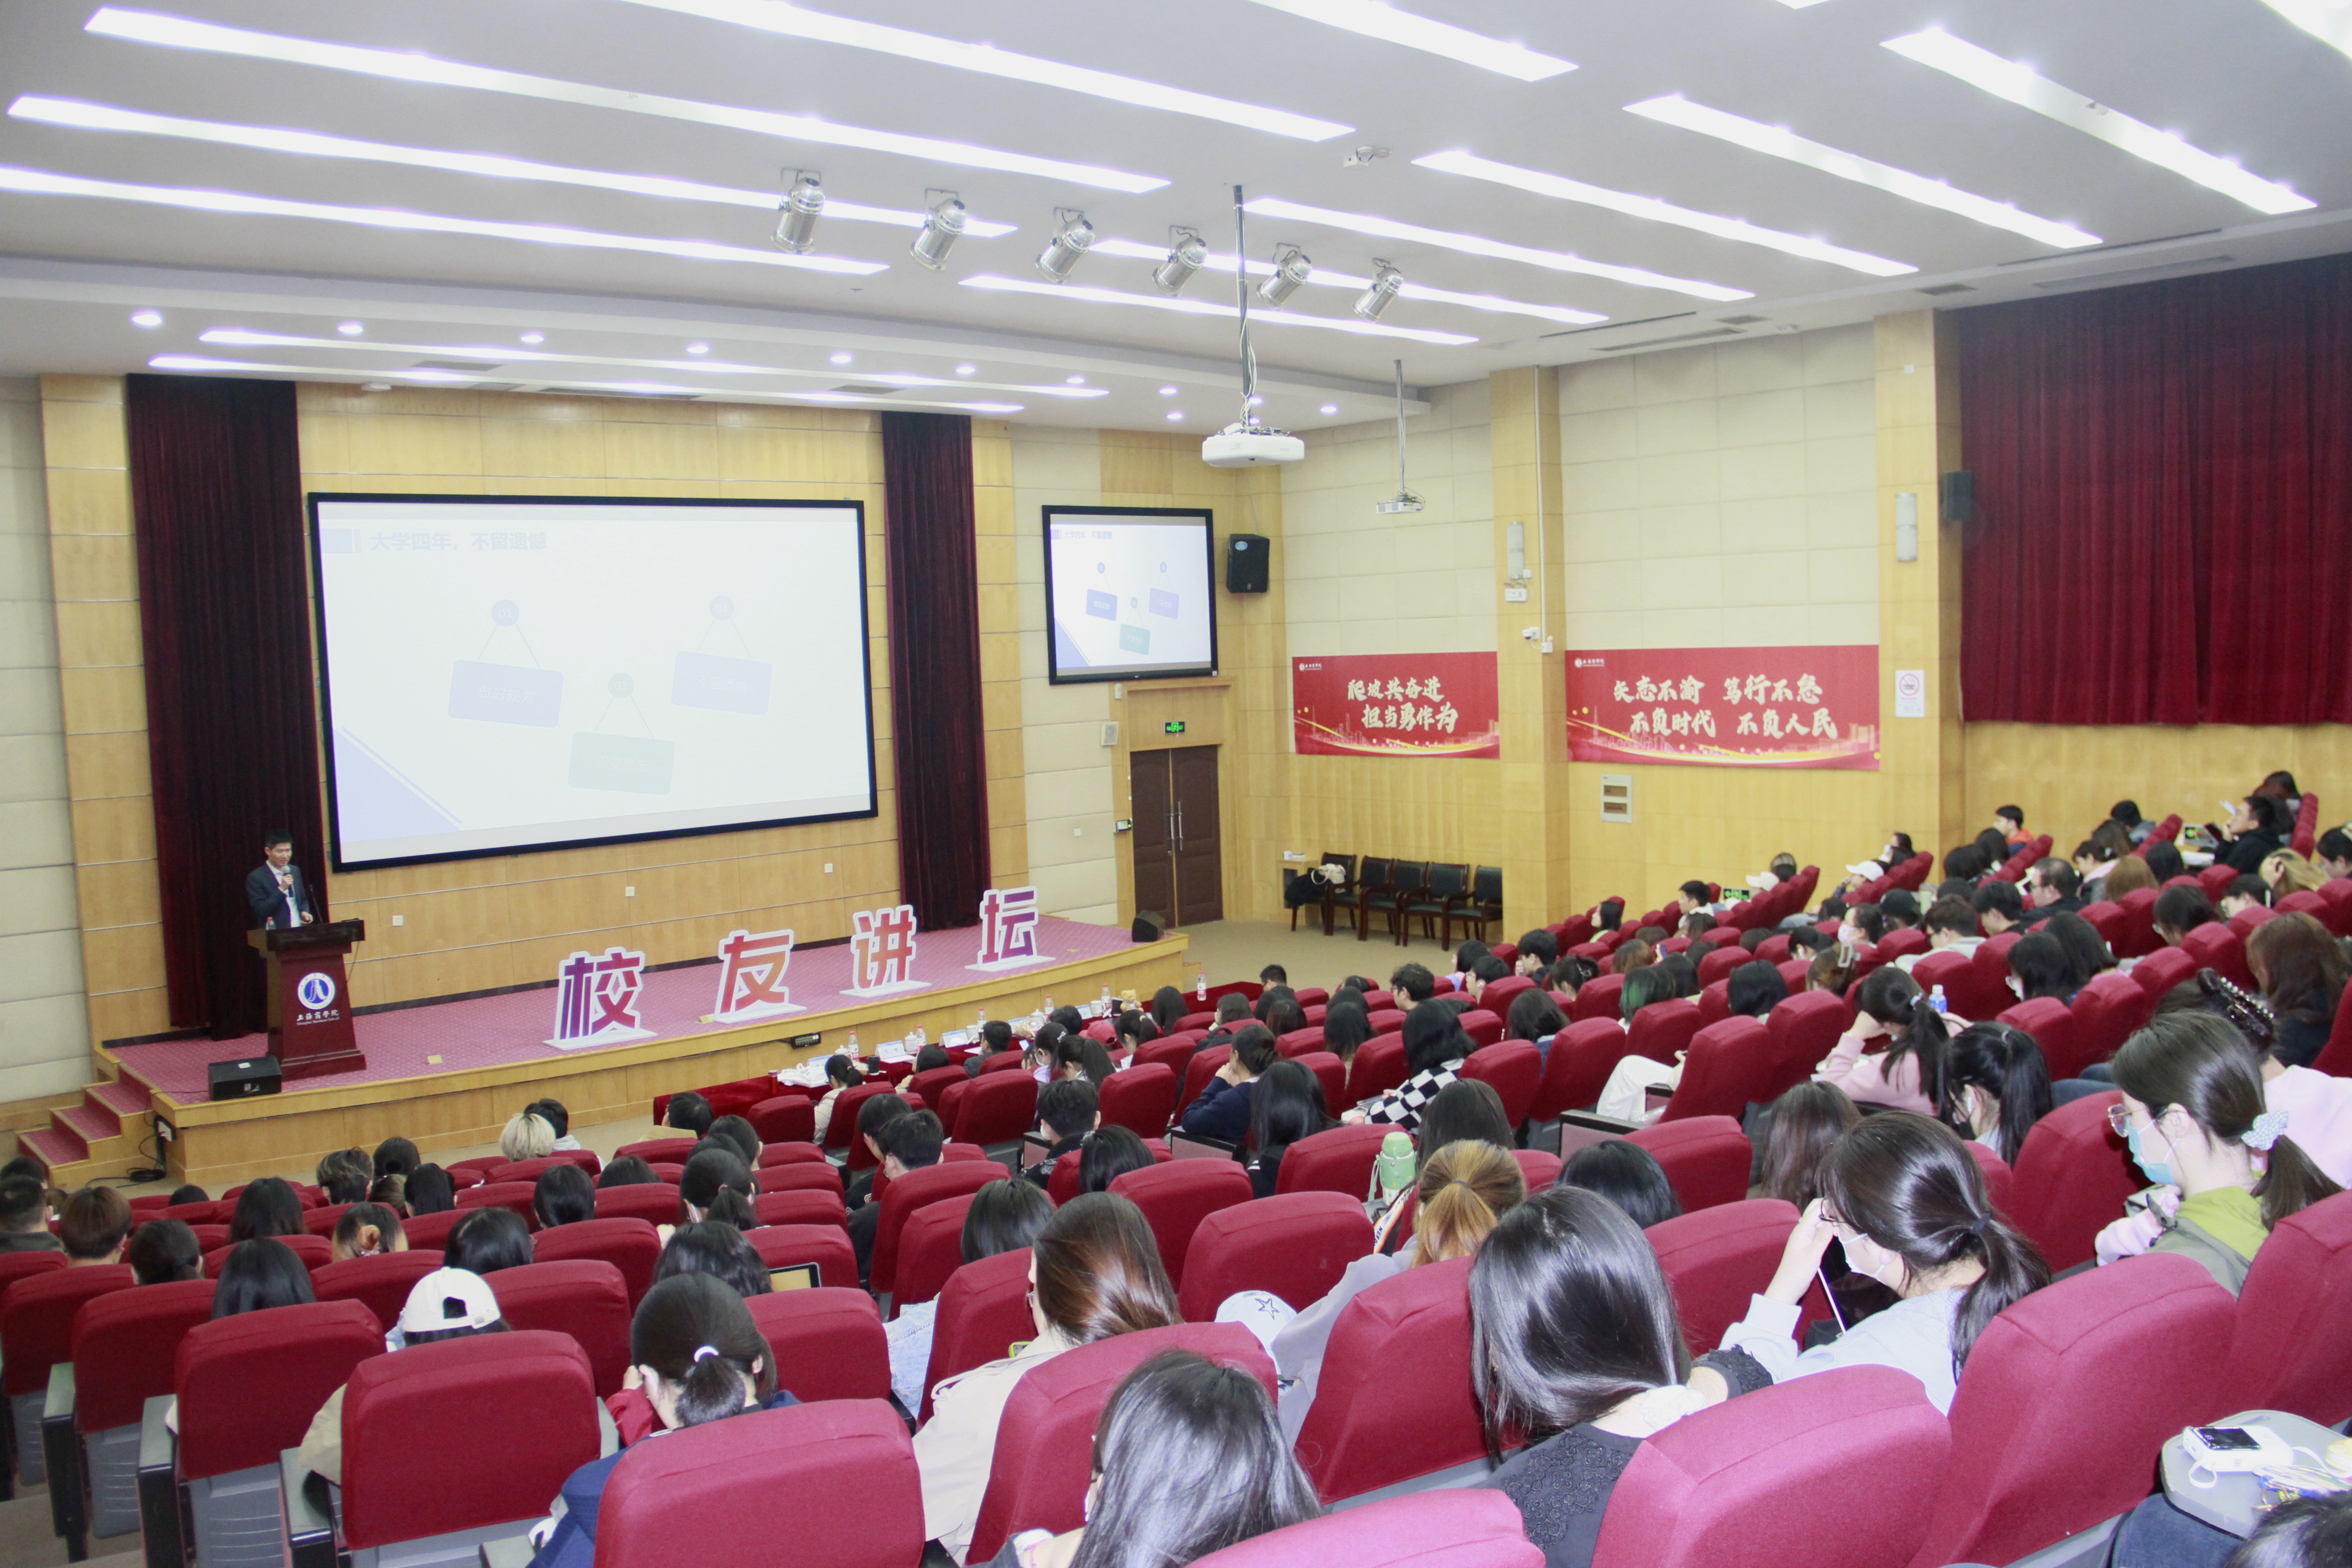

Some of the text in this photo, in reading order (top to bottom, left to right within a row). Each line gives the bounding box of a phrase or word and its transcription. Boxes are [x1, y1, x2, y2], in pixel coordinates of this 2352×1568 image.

[498, 609, 513, 619] 01
[479, 686, 536, 704] 做好规划
[614, 681, 627, 691] 02
[1348, 676, 1445, 702] 爬坡共奋进
[1613, 673, 1823, 705] 矢志不渝 笃行不怠
[1361, 701, 1459, 734] 担当勇作为
[1629, 707, 1838, 740] 不负时代 不负人民
[558, 887, 1037, 1041] 校友讲坛
